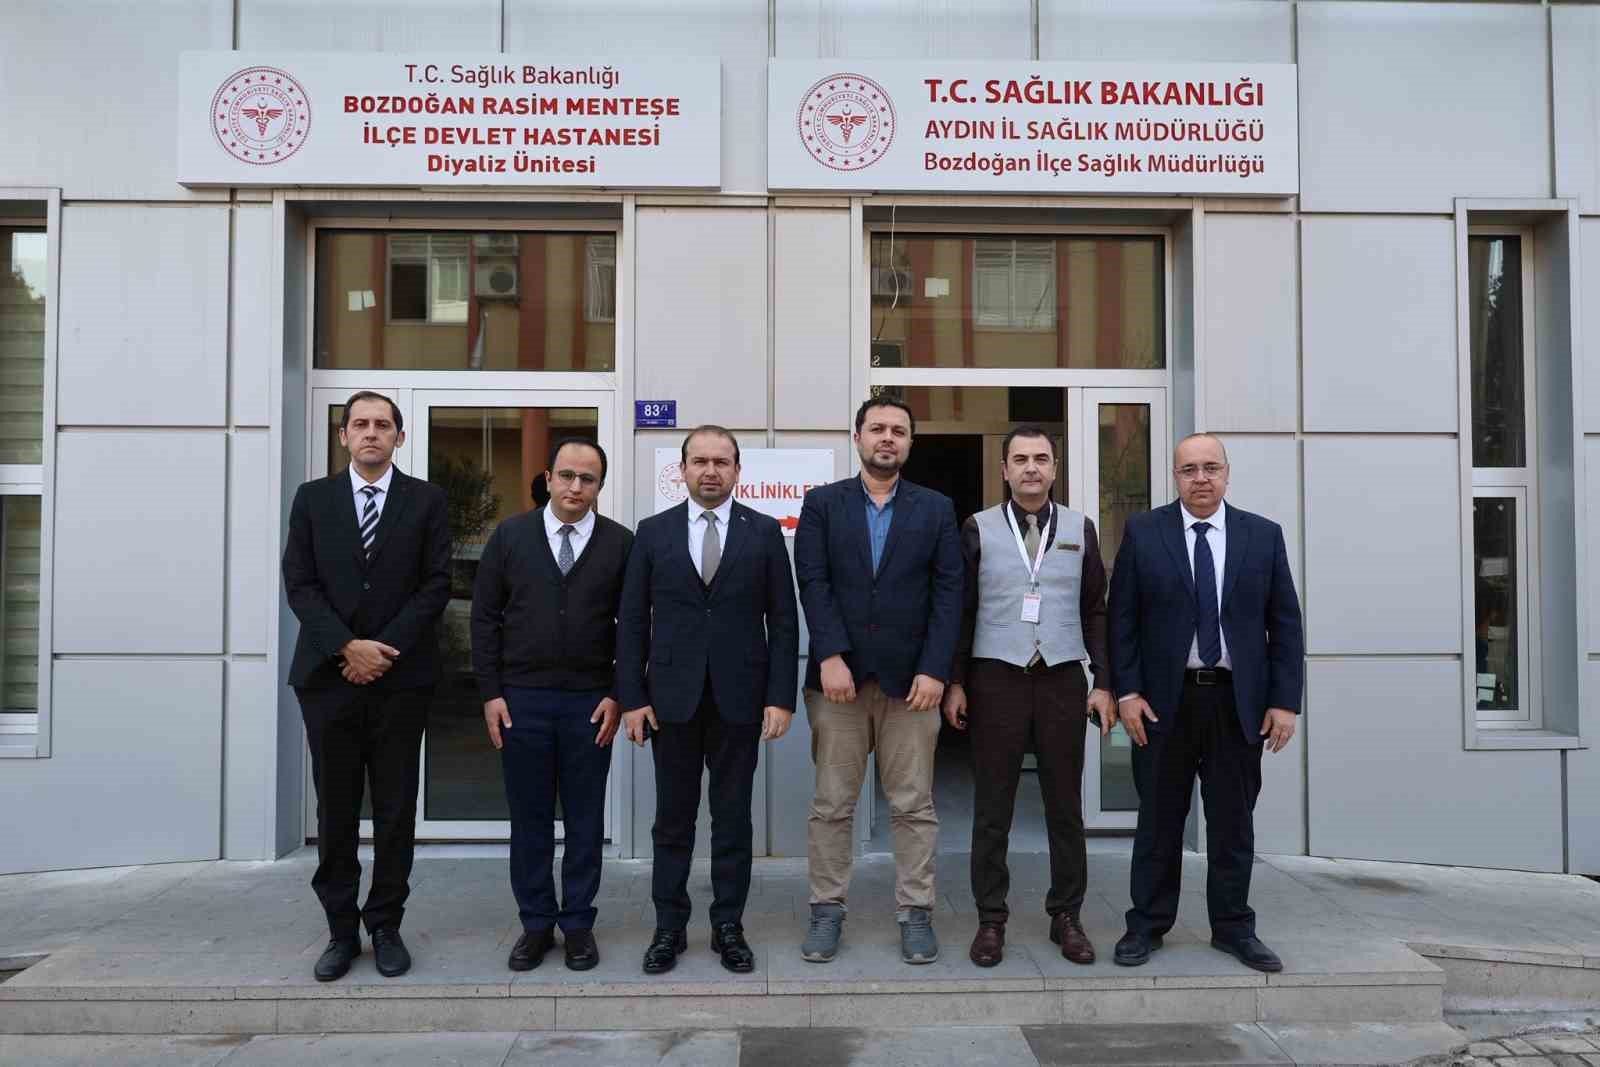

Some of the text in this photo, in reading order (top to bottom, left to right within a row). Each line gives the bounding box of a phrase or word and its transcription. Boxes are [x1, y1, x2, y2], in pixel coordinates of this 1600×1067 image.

[404, 64, 620, 90] T.C. Sağlık Bakanlığı
[924, 74, 1264, 107] T.C. SAĞLIK BAKANLIĞI
[344, 92, 681, 121] BOZDOĞAN RASİM MENTEŞE
[363, 122, 660, 148] İLÇE DEVLET HASTANESİ
[924, 116, 1264, 142] AYDIN İL SAĞLIK MÜDÜRLÜĞÜ
[427, 150, 596, 177] Diyaliz Ünitesi
[924, 149, 1265, 179] Bozdoğan İlçe Sağlık Müdürlüğü
